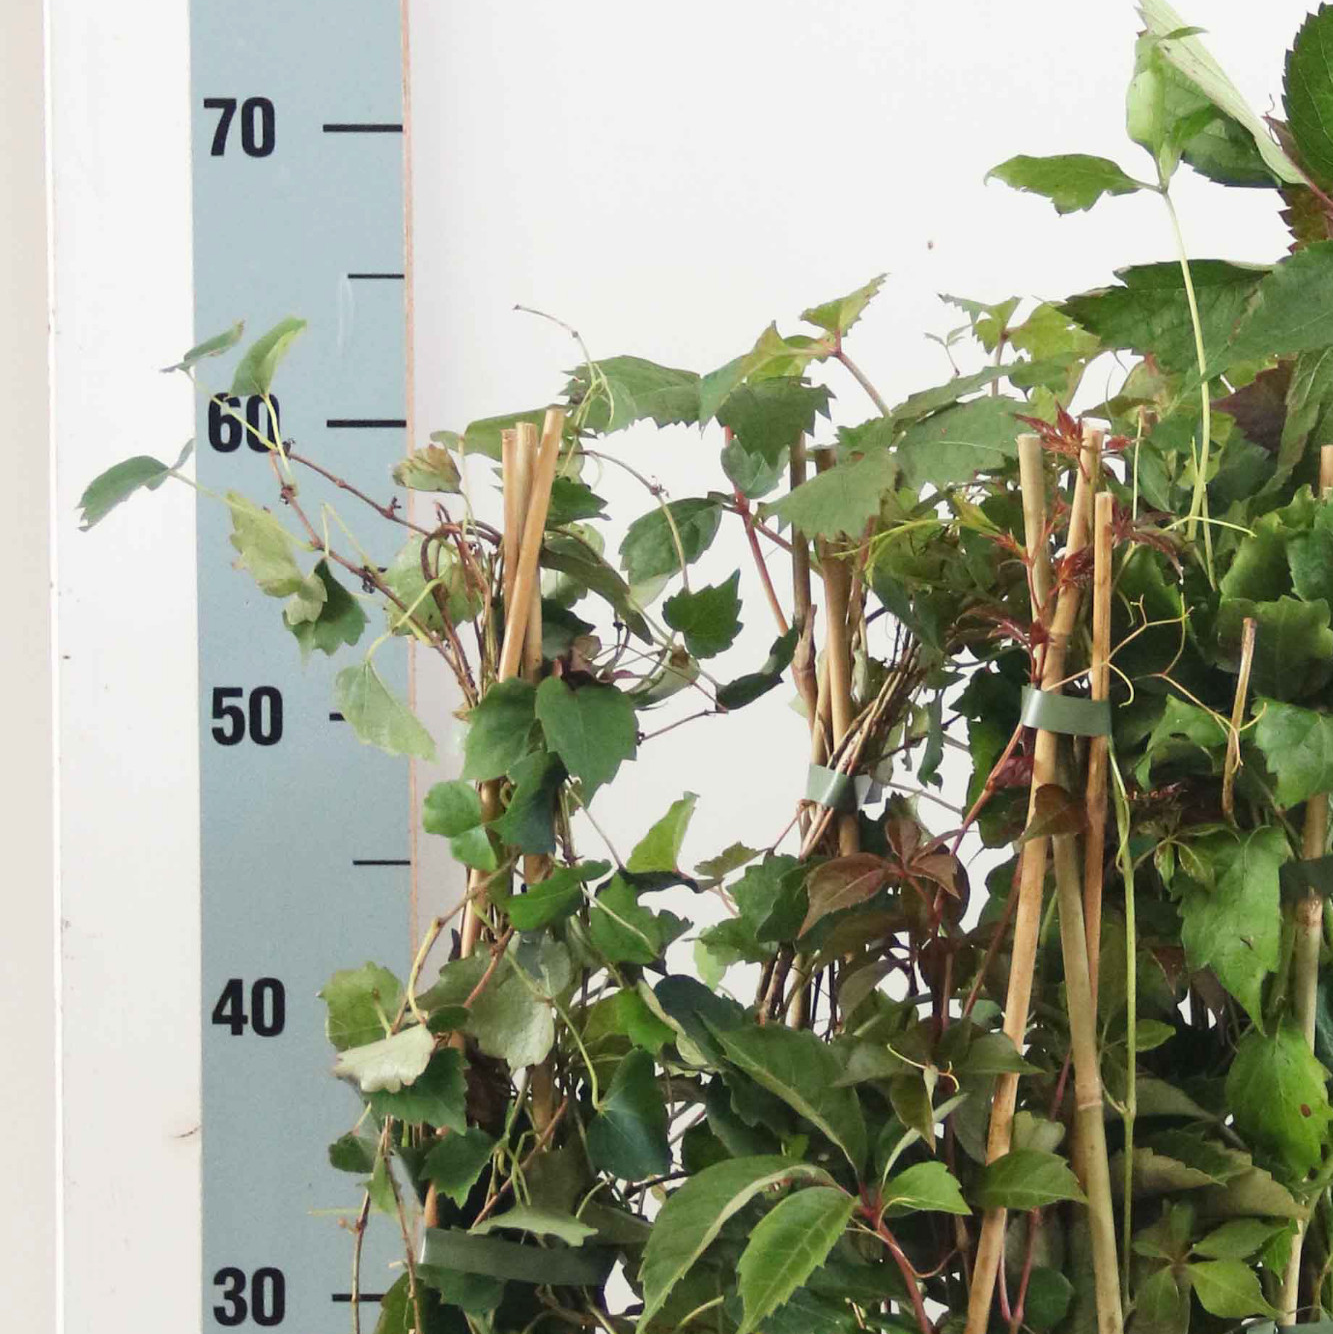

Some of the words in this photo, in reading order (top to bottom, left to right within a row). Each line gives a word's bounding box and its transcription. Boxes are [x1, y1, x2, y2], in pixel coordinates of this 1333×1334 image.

[203, 98, 274, 157] 70
[208, 392, 280, 453] 60
[211, 687, 283, 745] 50
[211, 978, 285, 1037] 40
[213, 1267, 285, 1326] 30
